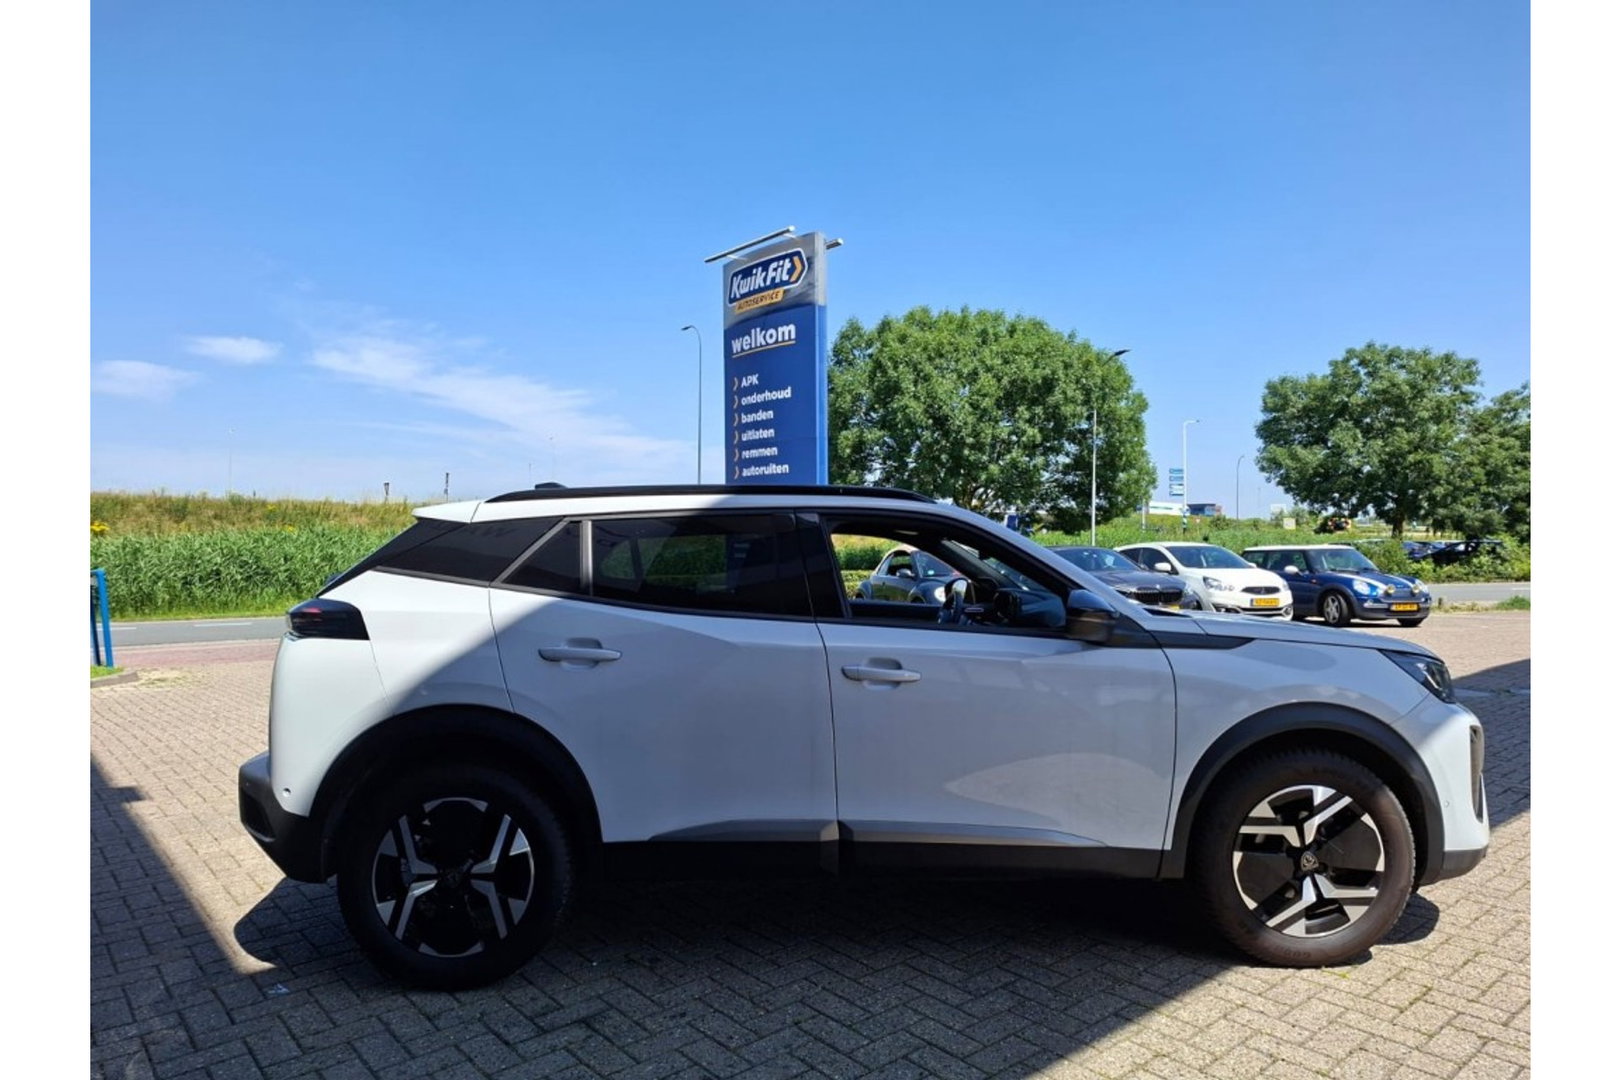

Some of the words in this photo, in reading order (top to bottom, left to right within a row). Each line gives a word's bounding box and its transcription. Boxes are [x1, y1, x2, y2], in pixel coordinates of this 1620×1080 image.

[737, 290, 781, 311] AUTOSERVICE
[732, 323, 796, 353] welkom
[741, 374, 759, 388] APK
[741, 386, 792, 405] onderhoud
[741, 409, 774, 423] banden
[742, 428, 775, 441] uitlaten
[742, 446, 778, 459] remmen
[742, 463, 789, 477] autoruiten
